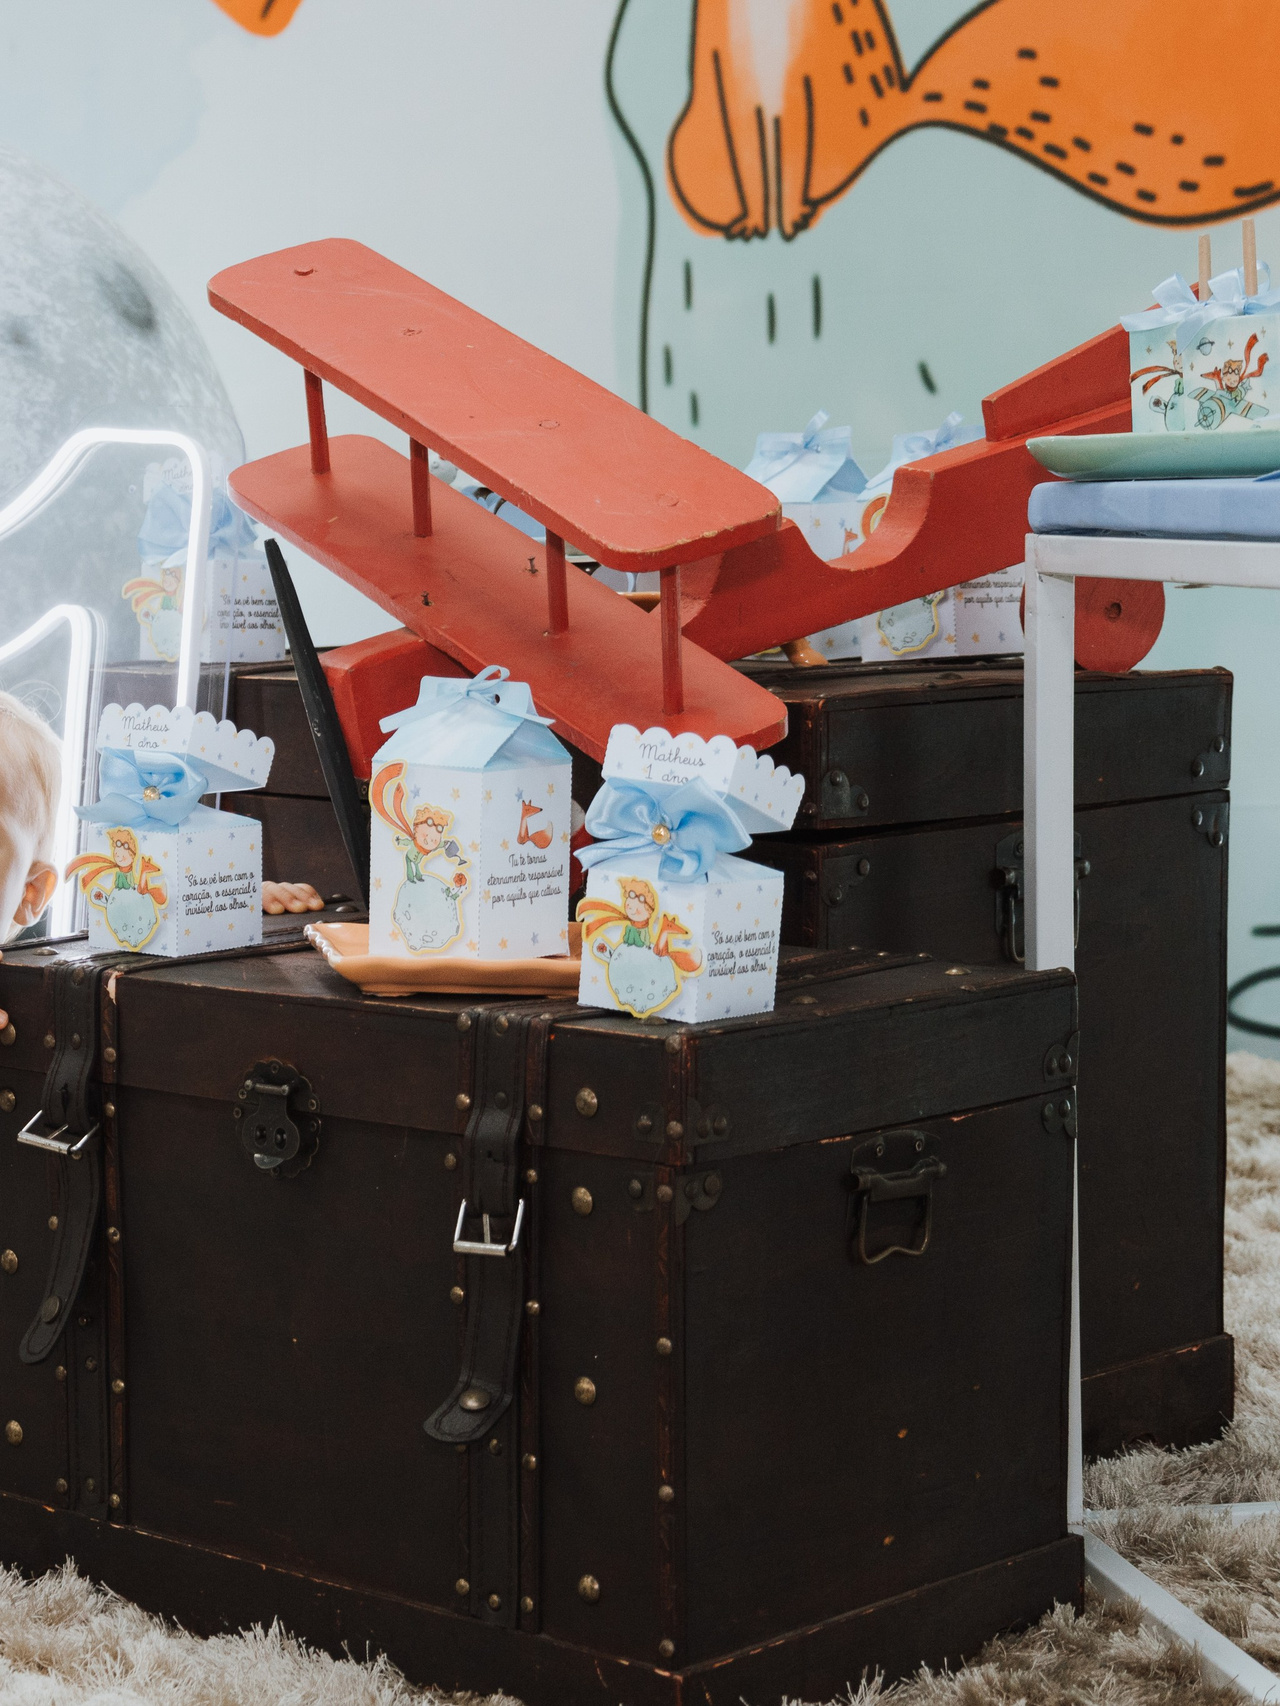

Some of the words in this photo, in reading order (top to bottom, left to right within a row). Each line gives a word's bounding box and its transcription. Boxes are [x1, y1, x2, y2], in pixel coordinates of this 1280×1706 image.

[122, 715, 170, 732] Matheus
[126, 733, 132, 747] 1
[138, 741, 160, 749] ano
[639, 743, 706, 767] Matheus
[645, 763, 652, 779] 1
[509, 853, 519, 867] Tu
[519, 854, 526, 865] te
[527, 852, 547, 864] tornas
[199, 877, 208, 885] se
[209, 873, 217, 884] vê
[218, 872, 233, 883] bem
[234, 872, 248, 881] com
[249, 871, 255, 879] o
[487, 869, 527, 886] eternamente
[528, 864, 564, 886] responsável
[182, 889, 212, 903] coração,
[215, 890, 220, 898] o
[221, 881, 251, 897] essencial
[252, 882, 257, 893] é
[492, 894, 505, 909] por
[506, 887, 527, 907] aquilo
[528, 890, 540, 904] que
[185, 901, 214, 915] invisível
[215, 903, 228, 912] aos
[725, 934, 733, 944] se
[734, 930, 742, 942] vê
[743, 929, 757, 942] bem
[758, 930, 770, 940] com
[707, 948, 736, 964] coração,
[739, 950, 744, 958] o
[745, 941, 771, 958] essencial
[708, 961, 736, 977] invisível
[737, 964, 749, 974] aos
